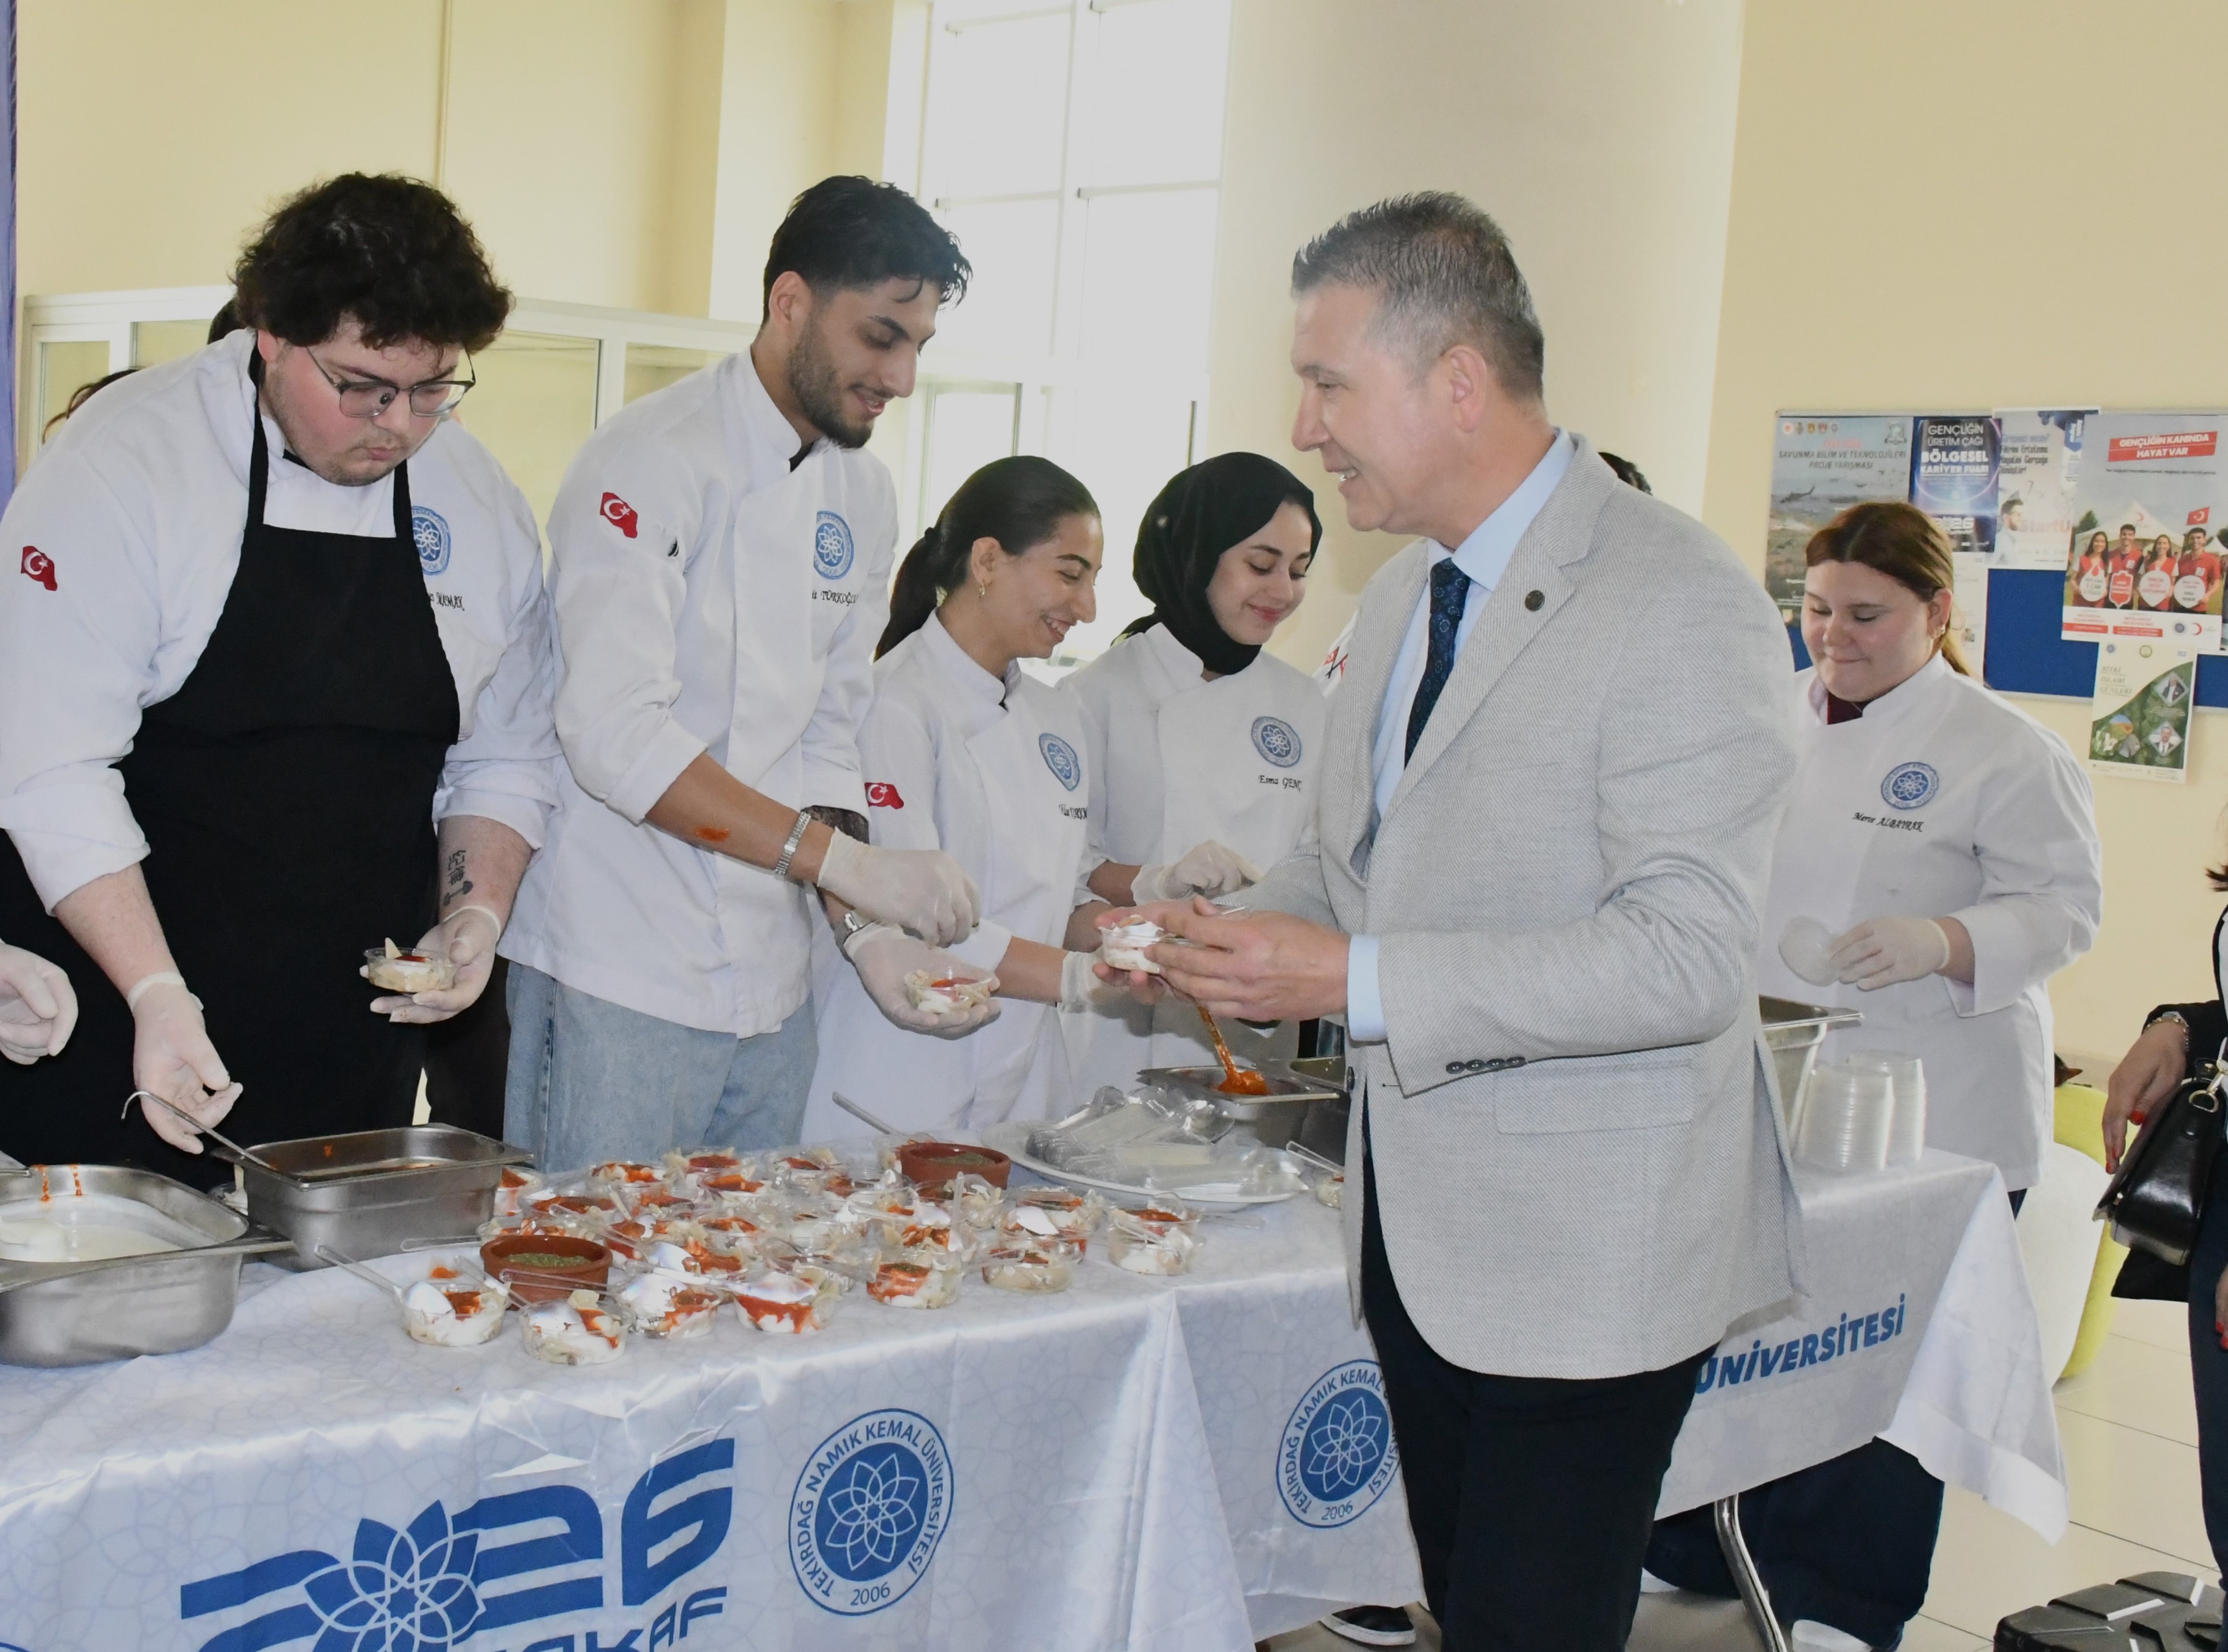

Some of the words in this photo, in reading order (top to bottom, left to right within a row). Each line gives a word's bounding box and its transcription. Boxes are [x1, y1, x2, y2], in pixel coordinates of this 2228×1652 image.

[2119, 435, 2166, 449] GENÇLİĞİN
[2167, 434, 2209, 445] KANINDA
[1779, 450, 1815, 459] SAVUNMA
[1921, 448, 1989, 463] BÖLGESEL
[2137, 448, 2168, 458] HAYAT
[2168, 447, 2188, 456] VAR
[1258, 775, 1279, 785] Esma
[1294, 1378, 1338, 1431] NAMIK
[805, 1429, 862, 1493] NAMIK
[865, 1419, 923, 1447] KEMAL
[1321, 1500, 1353, 1521] 2006
[850, 1580, 891, 1606] 2006
